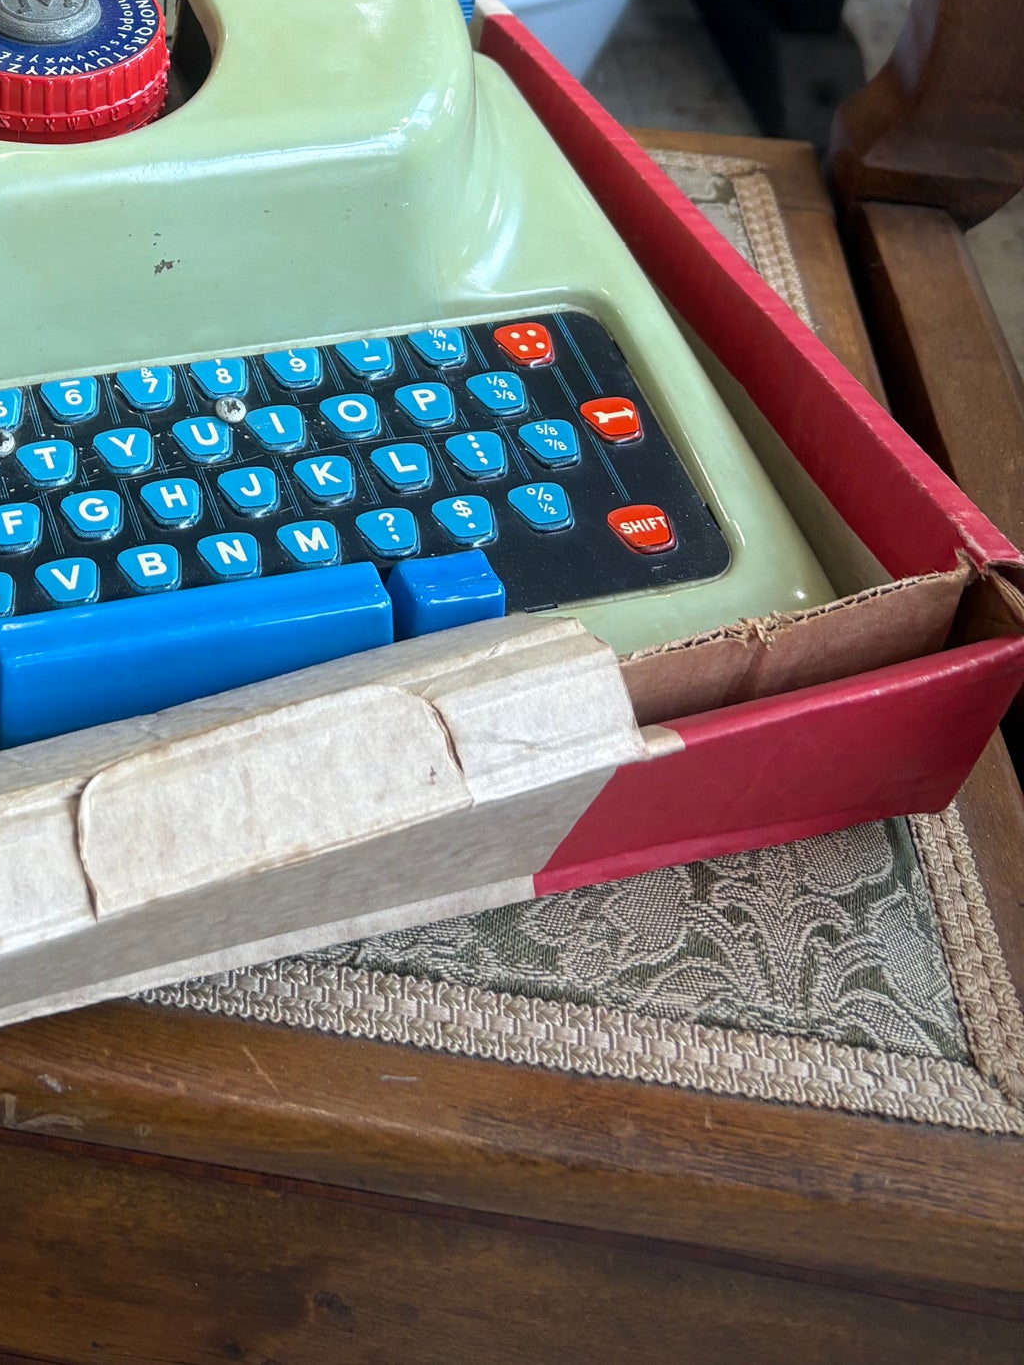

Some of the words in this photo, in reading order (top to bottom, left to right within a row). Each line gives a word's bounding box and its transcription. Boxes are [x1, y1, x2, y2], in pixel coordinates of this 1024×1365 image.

[64, 388, 83, 405] 6
[142, 377, 159, 394] 7
[215, 367, 233, 384] 8
[289, 357, 307, 373] 9
[33, 446, 57, 470] T
[108, 434, 136, 457] Y
[190, 422, 219, 446] U
[269, 412, 284, 434] I
[337, 399, 368, 423] O
[411, 389, 435, 411] P
[1, 509, 23, 535] F
[78, 497, 109, 522] G
[161, 484, 188, 508] H
[240, 473, 262, 497] J
[310, 461, 341, 486] K
[390, 451, 418, 473] L
[619, 516, 668, 535] SHIFT
[50, 564, 80, 590] V
[137, 552, 167, 577] B
[216, 539, 247, 564] N
[293, 527, 329, 553] M
[452, 499, 473, 518] $
